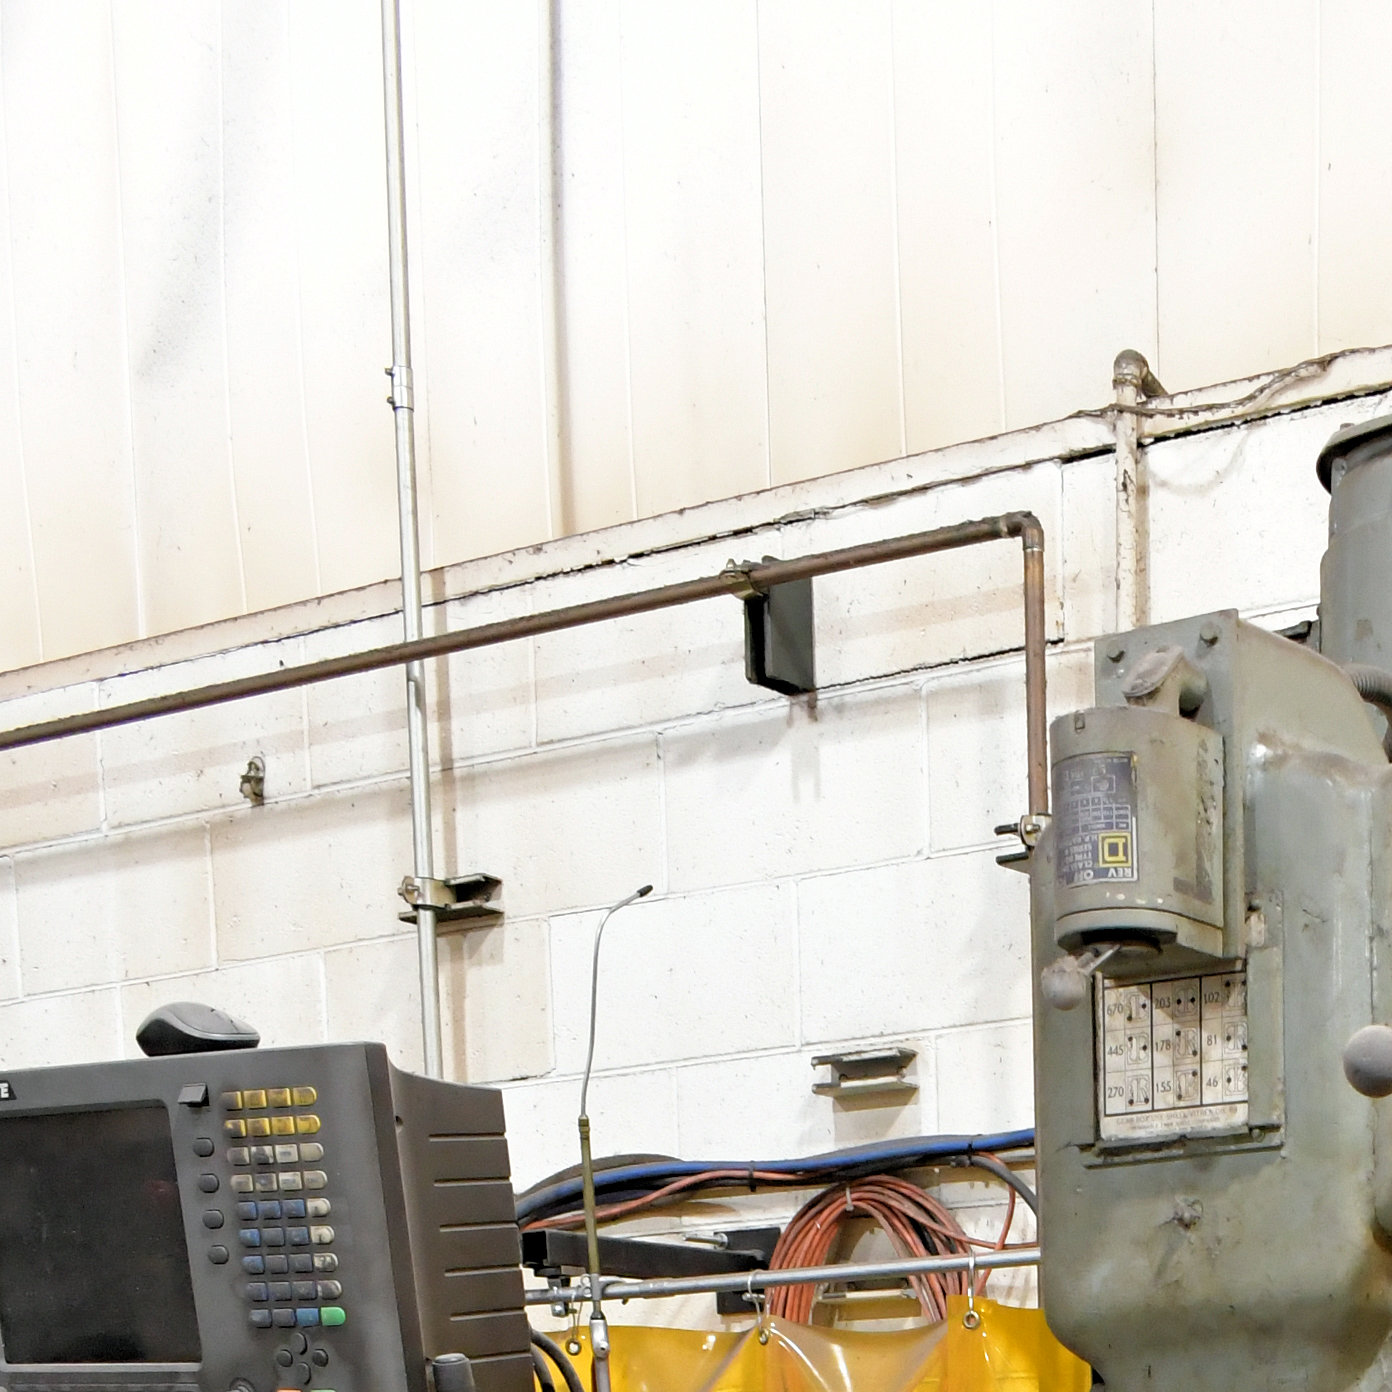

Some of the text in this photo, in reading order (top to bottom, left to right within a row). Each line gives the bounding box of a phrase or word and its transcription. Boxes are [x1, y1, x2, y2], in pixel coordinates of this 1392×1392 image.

[1108, 867, 1132, 878] REV
[1106, 991, 1220, 1016] 670 203 102
[1107, 1034, 1217, 1056] 445 178 81
[1107, 1075, 1219, 1099] 270 155 46
